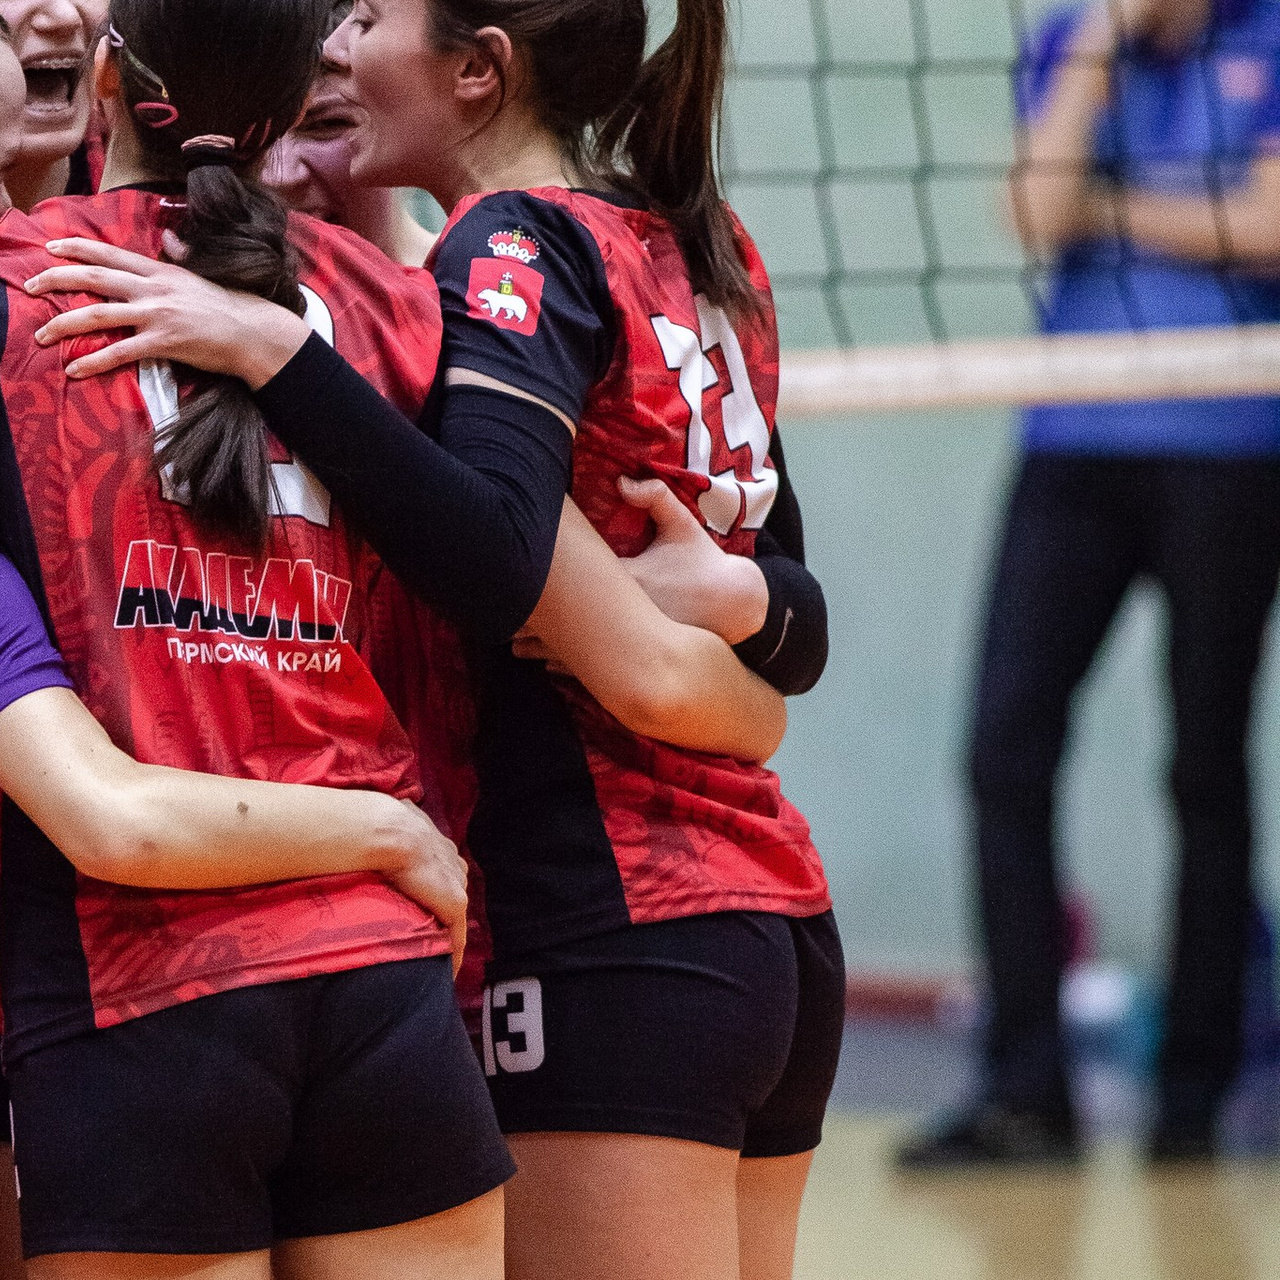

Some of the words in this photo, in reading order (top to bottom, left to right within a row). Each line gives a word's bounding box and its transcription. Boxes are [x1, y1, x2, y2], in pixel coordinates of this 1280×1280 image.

[167, 637, 270, 670] ПРМСКИЙ
[277, 648, 341, 673] КРАЙ
[482, 976, 545, 1077] 13
